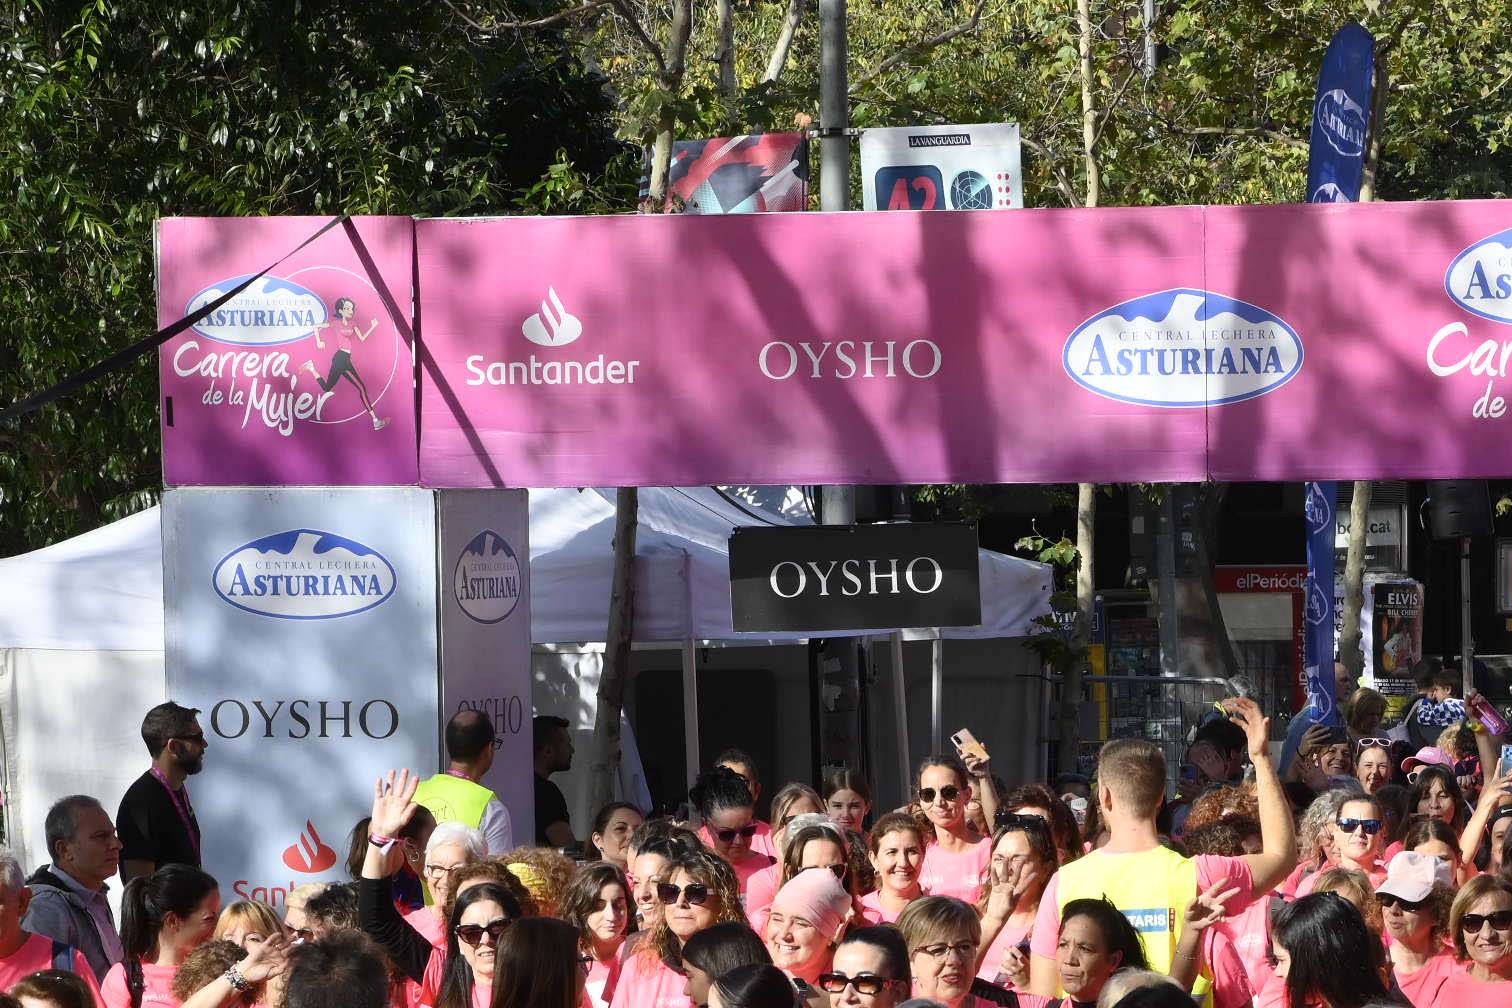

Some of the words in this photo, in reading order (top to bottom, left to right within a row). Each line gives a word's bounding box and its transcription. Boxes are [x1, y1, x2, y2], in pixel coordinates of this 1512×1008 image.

[197, 300, 317, 327] ASTURIANA
[1118, 328, 1194, 342] CENTRAL
[1201, 327, 1277, 341] LECHERA
[173, 341, 290, 378] Carrera
[466, 354, 640, 386] Santander
[758, 339, 942, 380] OYSHO
[1082, 334, 1285, 377] ASTURIANA
[202, 380, 224, 406] de
[229, 379, 244, 406] la
[241, 376, 336, 437] Mujer
[1472, 383, 1507, 419] de
[227, 563, 384, 597] ASTURIANA
[255, 560, 313, 569] CENTRAL
[318, 560, 377, 569] LECHERA
[770, 556, 943, 598] OYSHO
[459, 565, 518, 600] ASTURIANA
[1388, 593, 1418, 605] ELVIS
[210, 699, 400, 739] OYSHO
